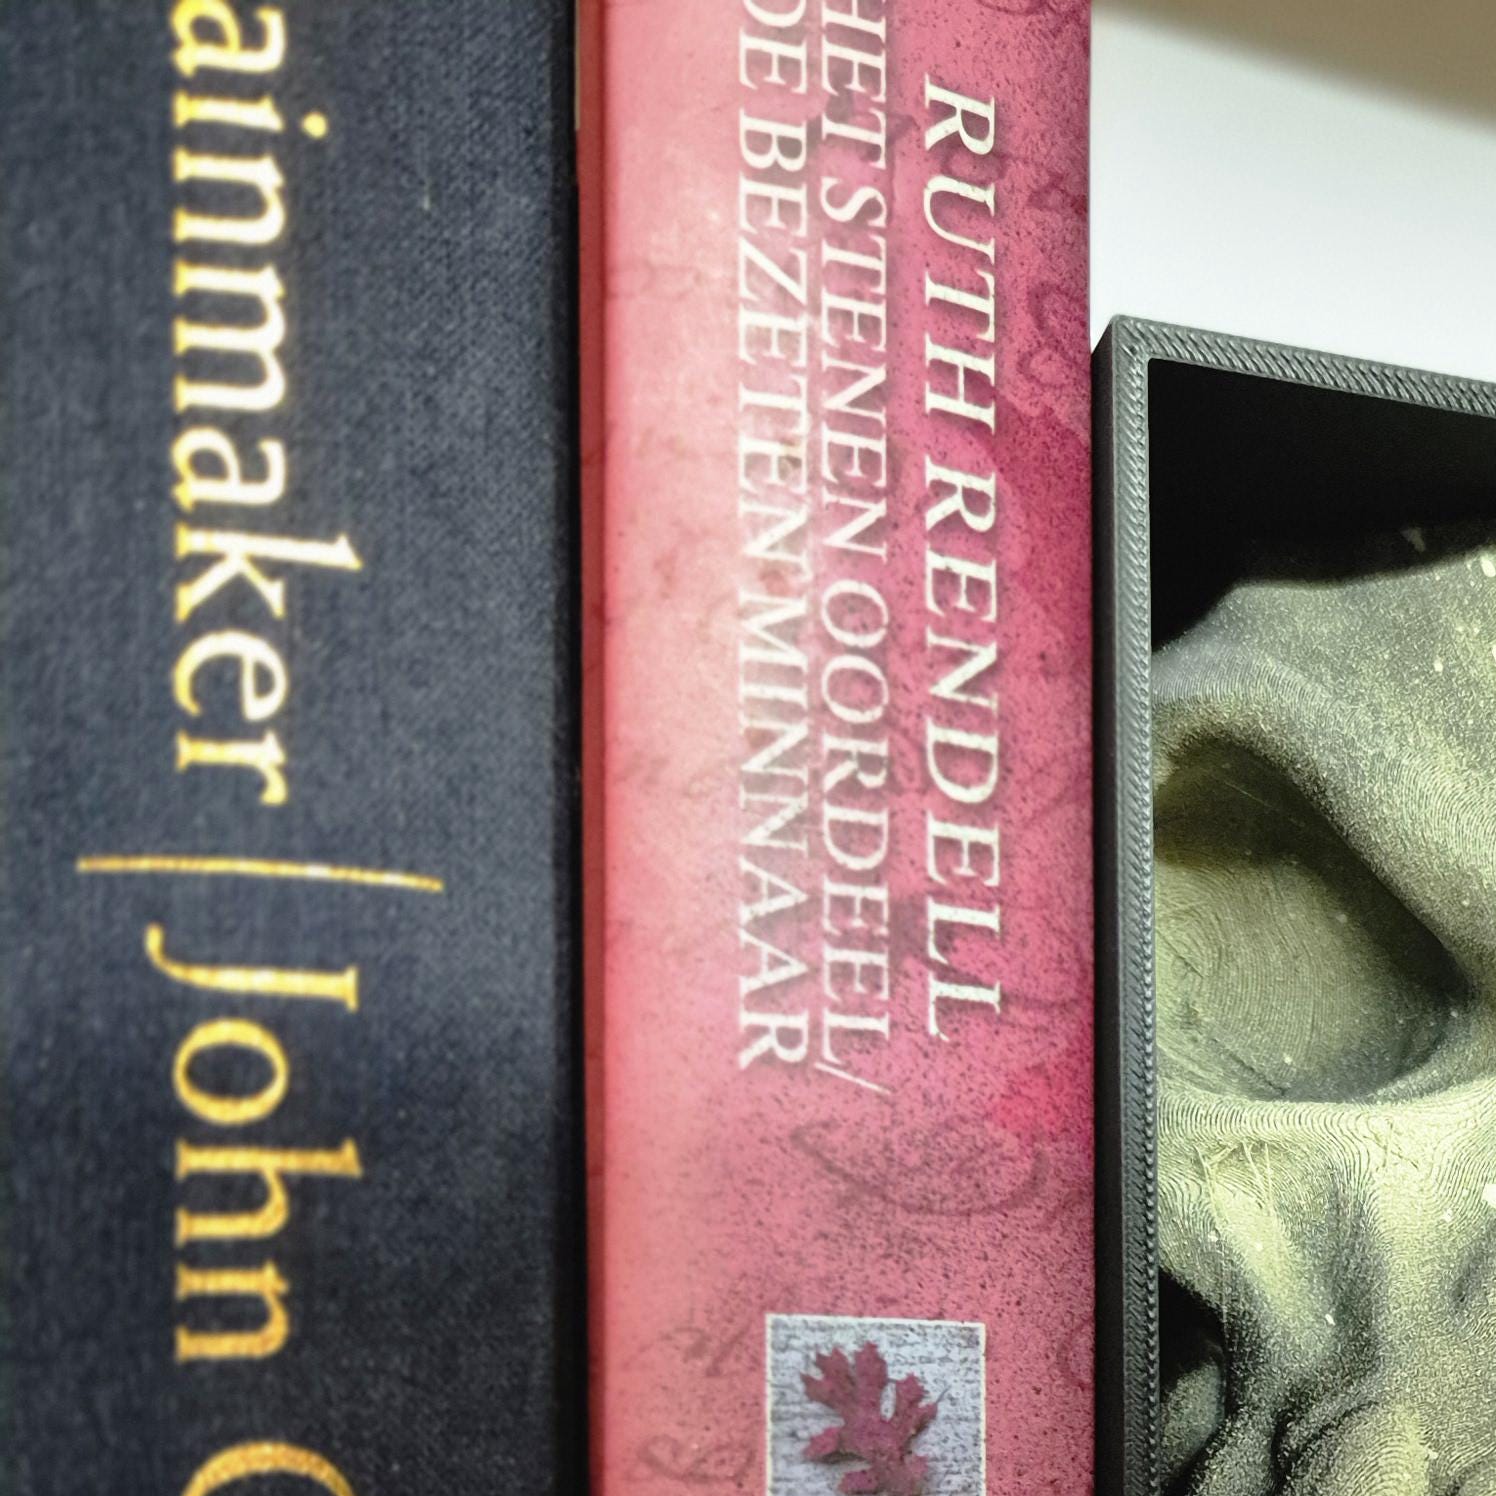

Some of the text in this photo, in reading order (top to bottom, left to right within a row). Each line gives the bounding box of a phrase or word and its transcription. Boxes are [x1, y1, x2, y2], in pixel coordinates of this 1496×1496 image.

[738, 106, 811, 582] BEZETEN
[820, 176, 889, 563] STENEN
[923, 72, 1001, 1043] RUTH RENDELL
[738, 586, 809, 1071] MINNAAR
[145, 923, 362, 1364] John
